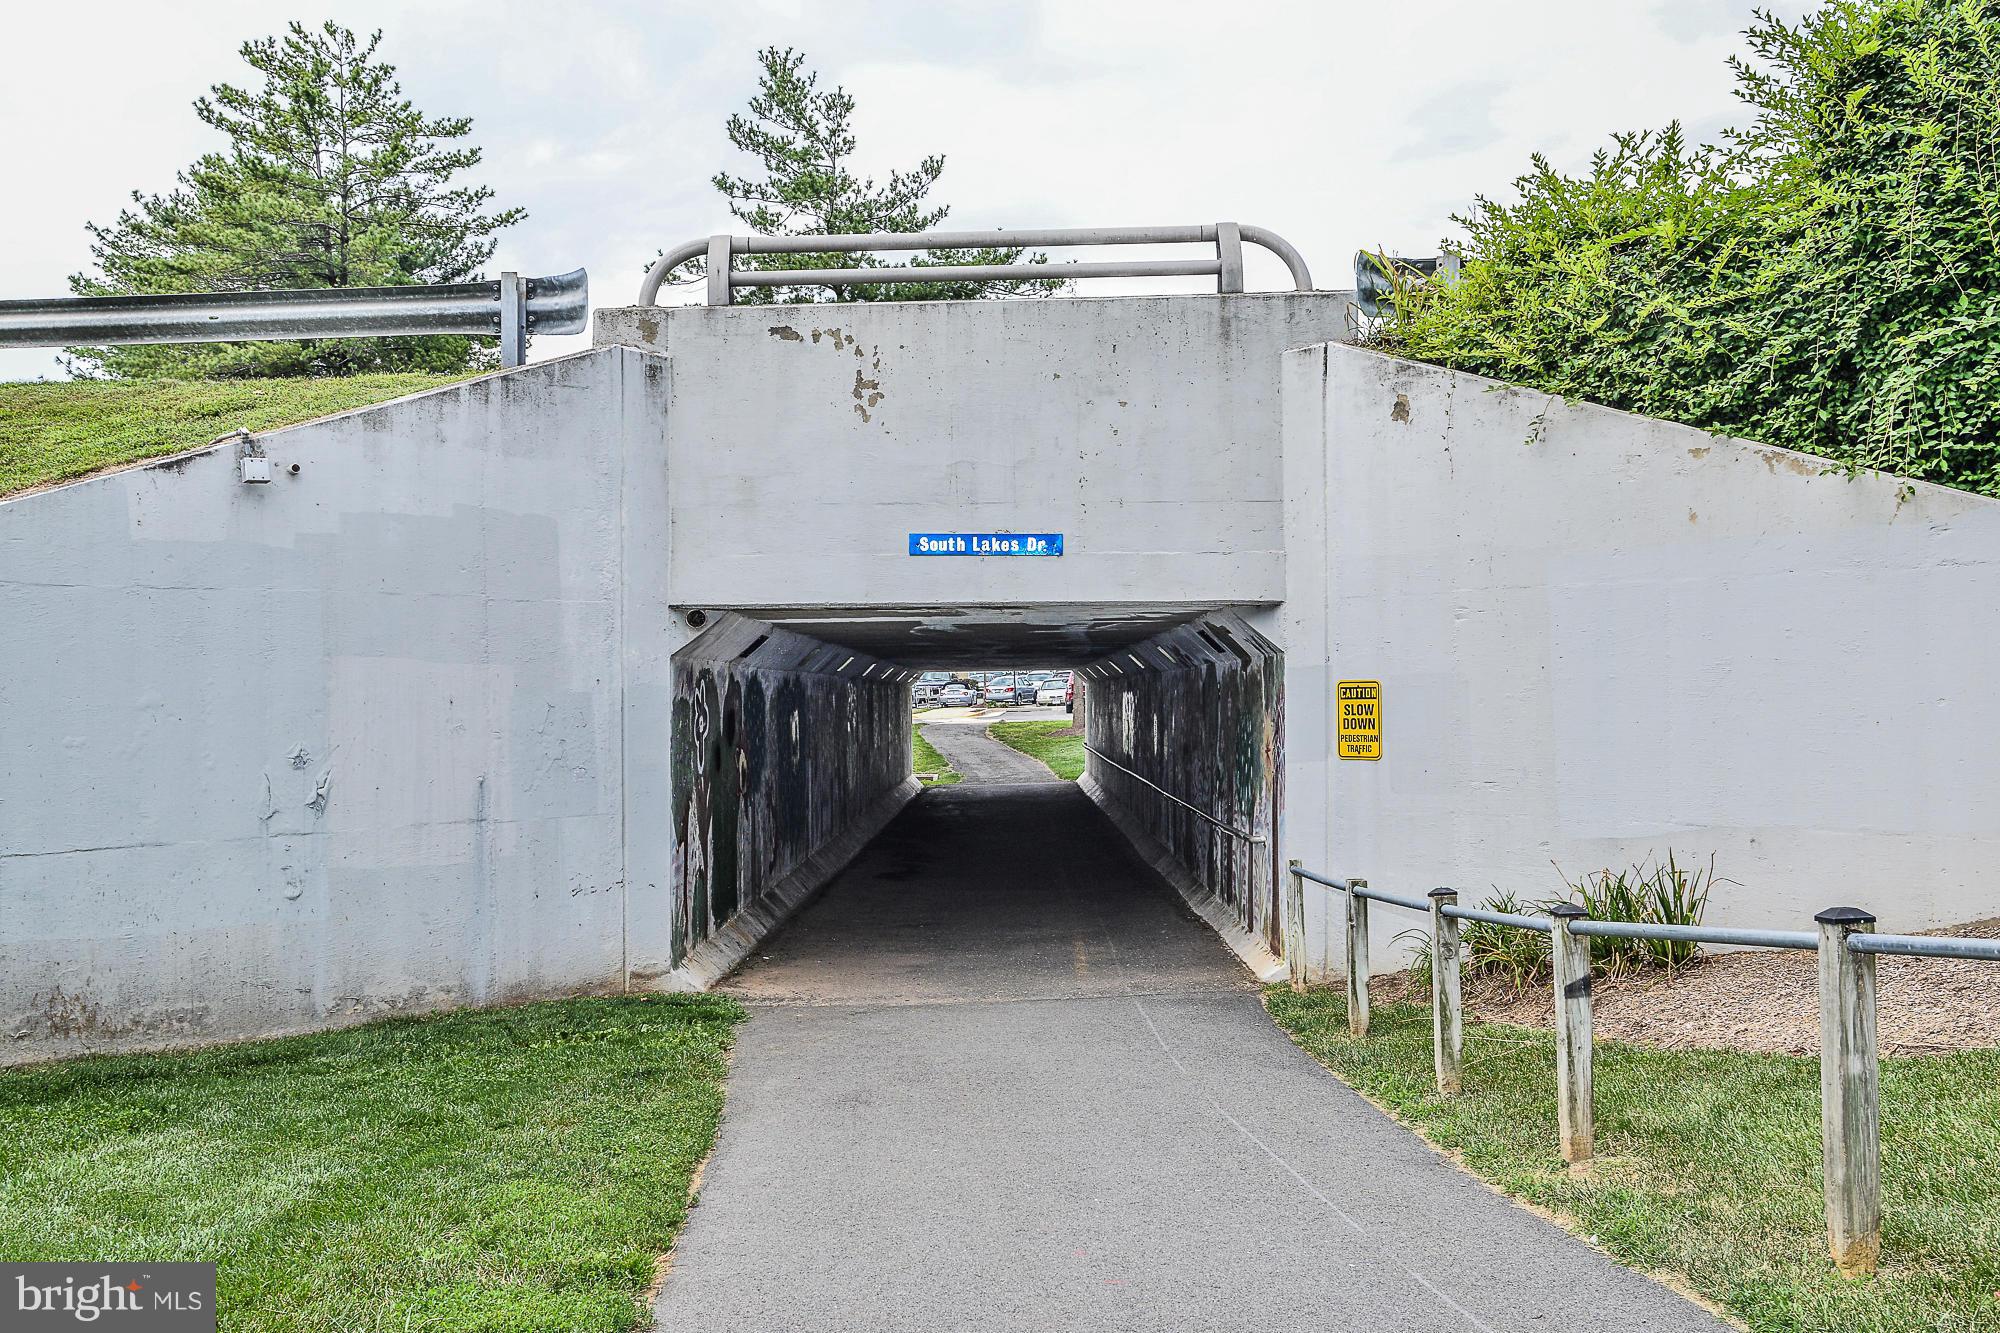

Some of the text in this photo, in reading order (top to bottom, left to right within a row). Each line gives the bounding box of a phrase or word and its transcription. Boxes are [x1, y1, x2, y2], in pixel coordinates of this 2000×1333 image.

[919, 536, 966, 552] South
[972, 536, 1019, 552] Lakes
[1340, 688, 1377, 698] CAUTION
[1343, 703, 1375, 716] SLOW
[1343, 718, 1375, 730] DOWN
[1340, 734, 1379, 743] PEDESTRIAN
[1346, 744, 1373, 753] TRAFFIC
